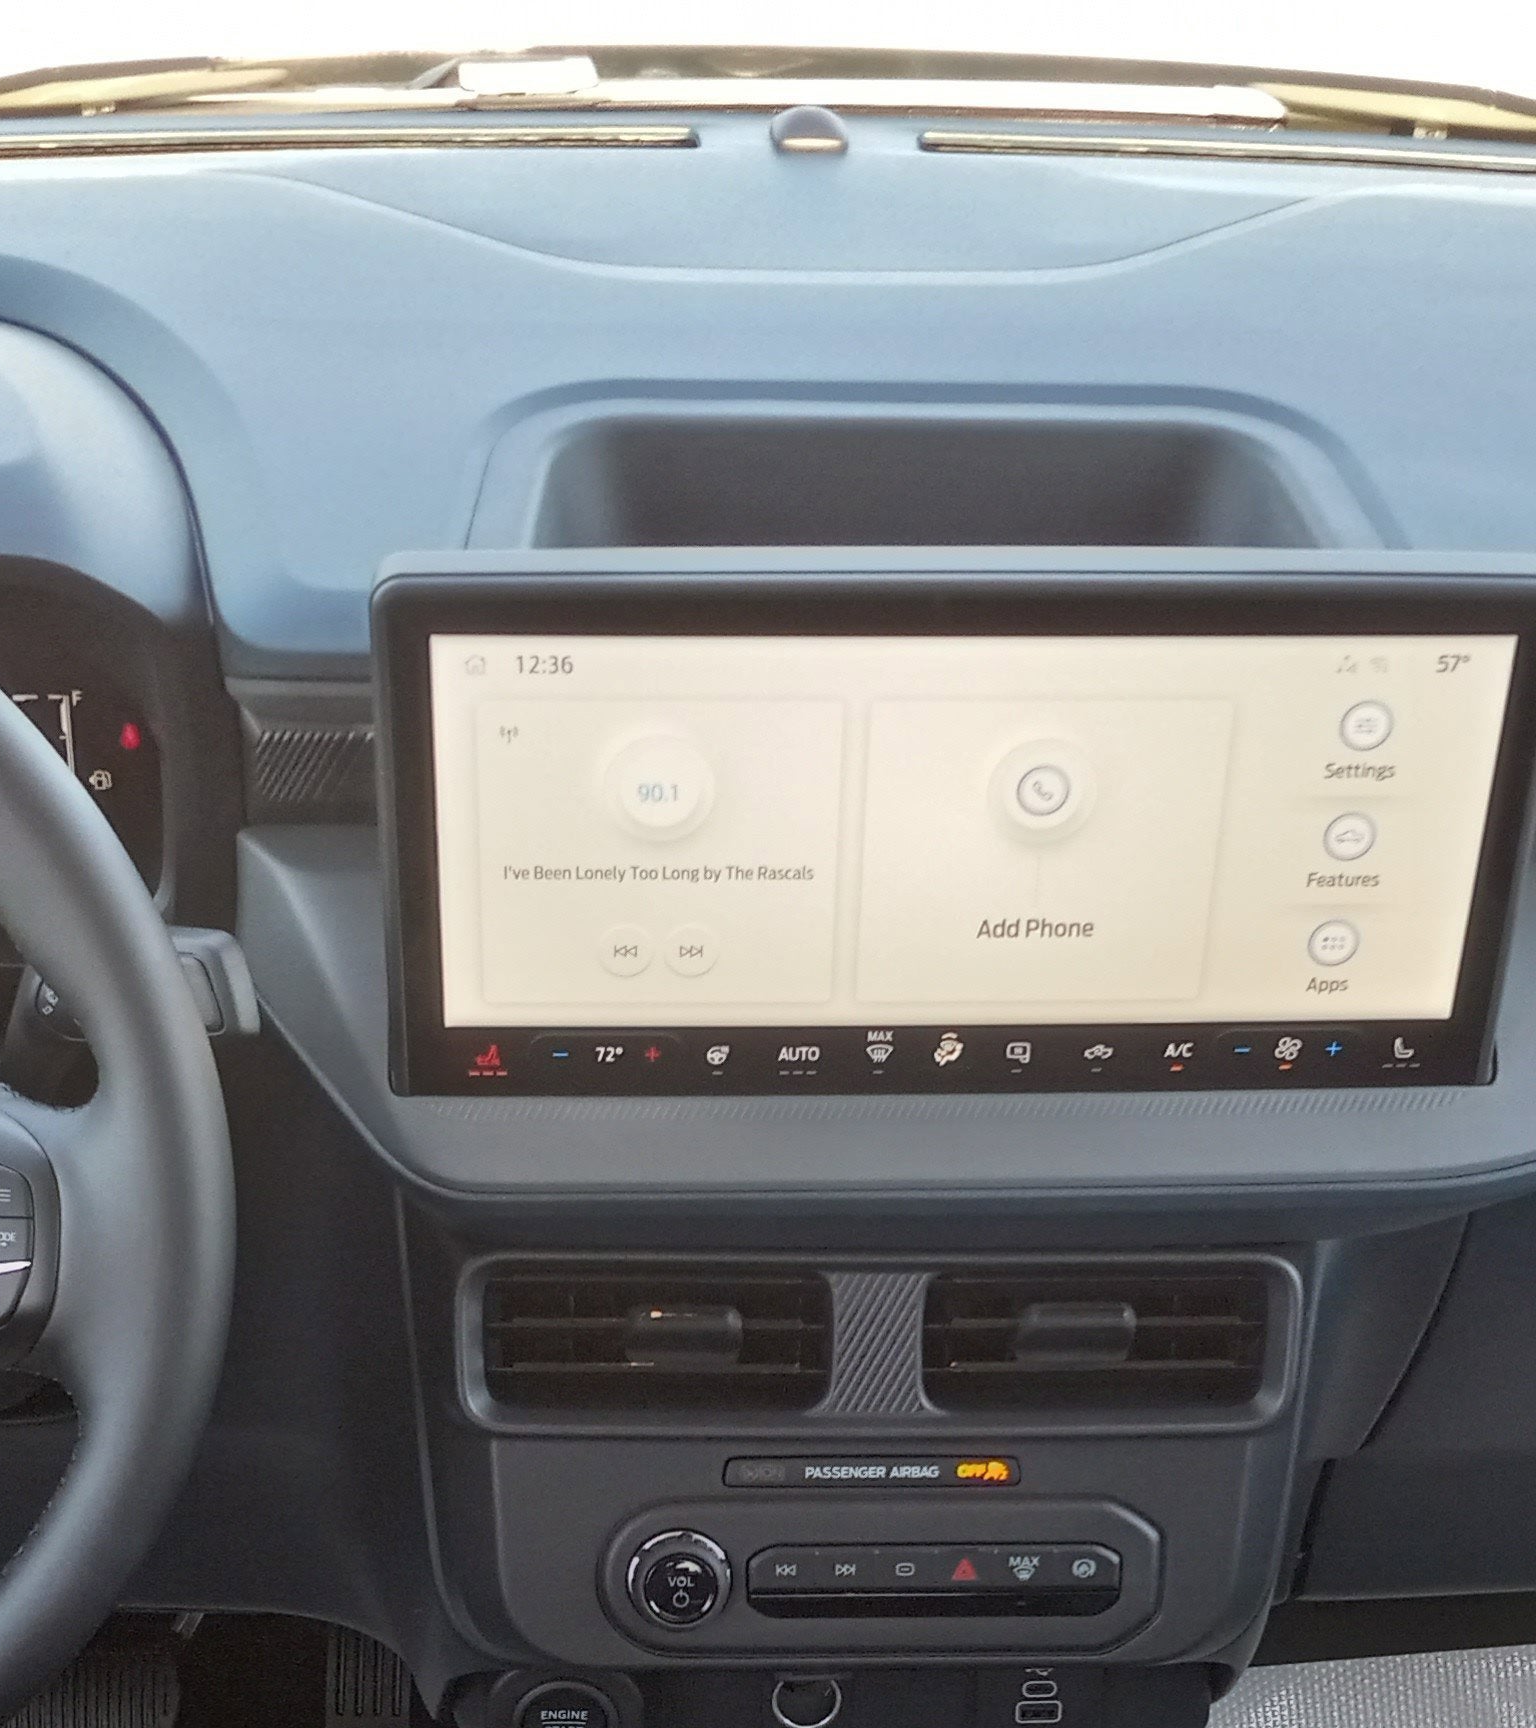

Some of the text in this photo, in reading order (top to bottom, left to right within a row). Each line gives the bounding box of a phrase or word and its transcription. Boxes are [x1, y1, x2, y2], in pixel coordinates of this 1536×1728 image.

[516, 655, 574, 675] 12:36
[1435, 655, 1471, 674] 57°
[72, 690, 82, 706] F
[1323, 762, 1396, 781] Settings
[637, 783, 679, 803] 90.1
[503, 866, 815, 884] I've Been Lonely Too Long by The Rascals
[1306, 872, 1380, 888] Features
[976, 918, 1095, 939] Add Phone
[1306, 976, 1349, 994] Apps
[867, 1030, 894, 1042] MAX
[777, 1046, 820, 1062] AUTO
[1164, 1042, 1194, 1058] A/C
[804, 1464, 940, 1479] PASSENGER AIRBAG
[1008, 1556, 1040, 1567] MAX
[668, 1576, 695, 1587] VOL
[541, 1710, 588, 1720] ENGINE
